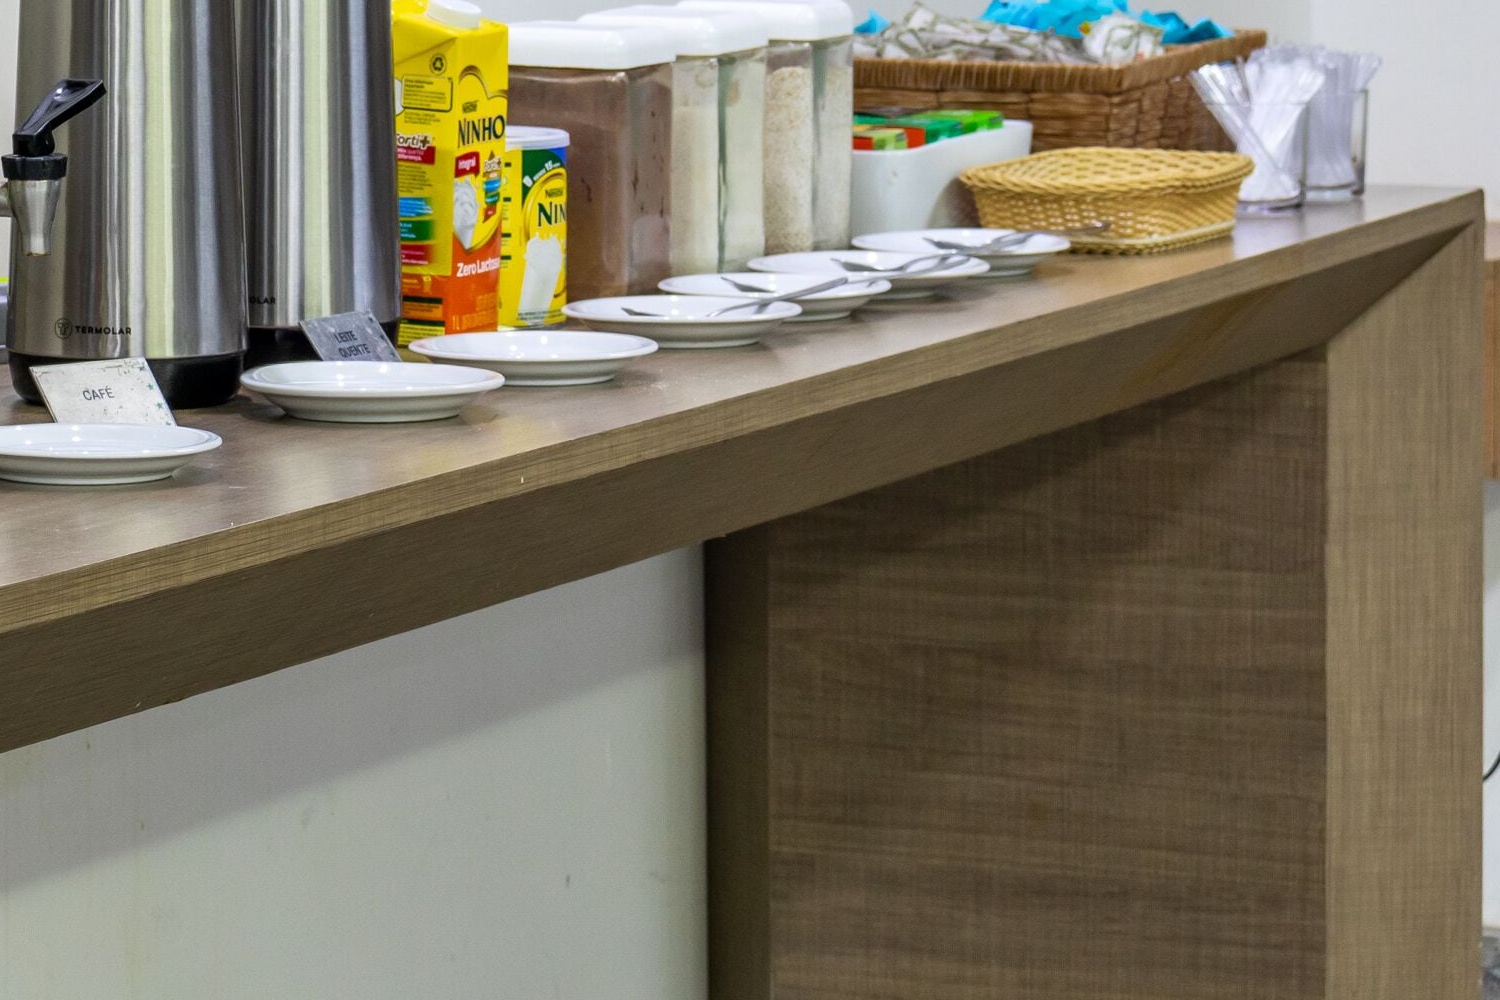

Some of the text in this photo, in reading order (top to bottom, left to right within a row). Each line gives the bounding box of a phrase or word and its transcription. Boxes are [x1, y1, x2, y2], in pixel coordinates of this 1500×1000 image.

[457, 115, 505, 148] NINHO
[456, 263, 477, 277] Zero
[75, 326, 132, 335] TERMOLAR
[334, 331, 357, 343] LEITE
[338, 343, 371, 358] QUENTE
[82, 385, 115, 401] CAFÉ
